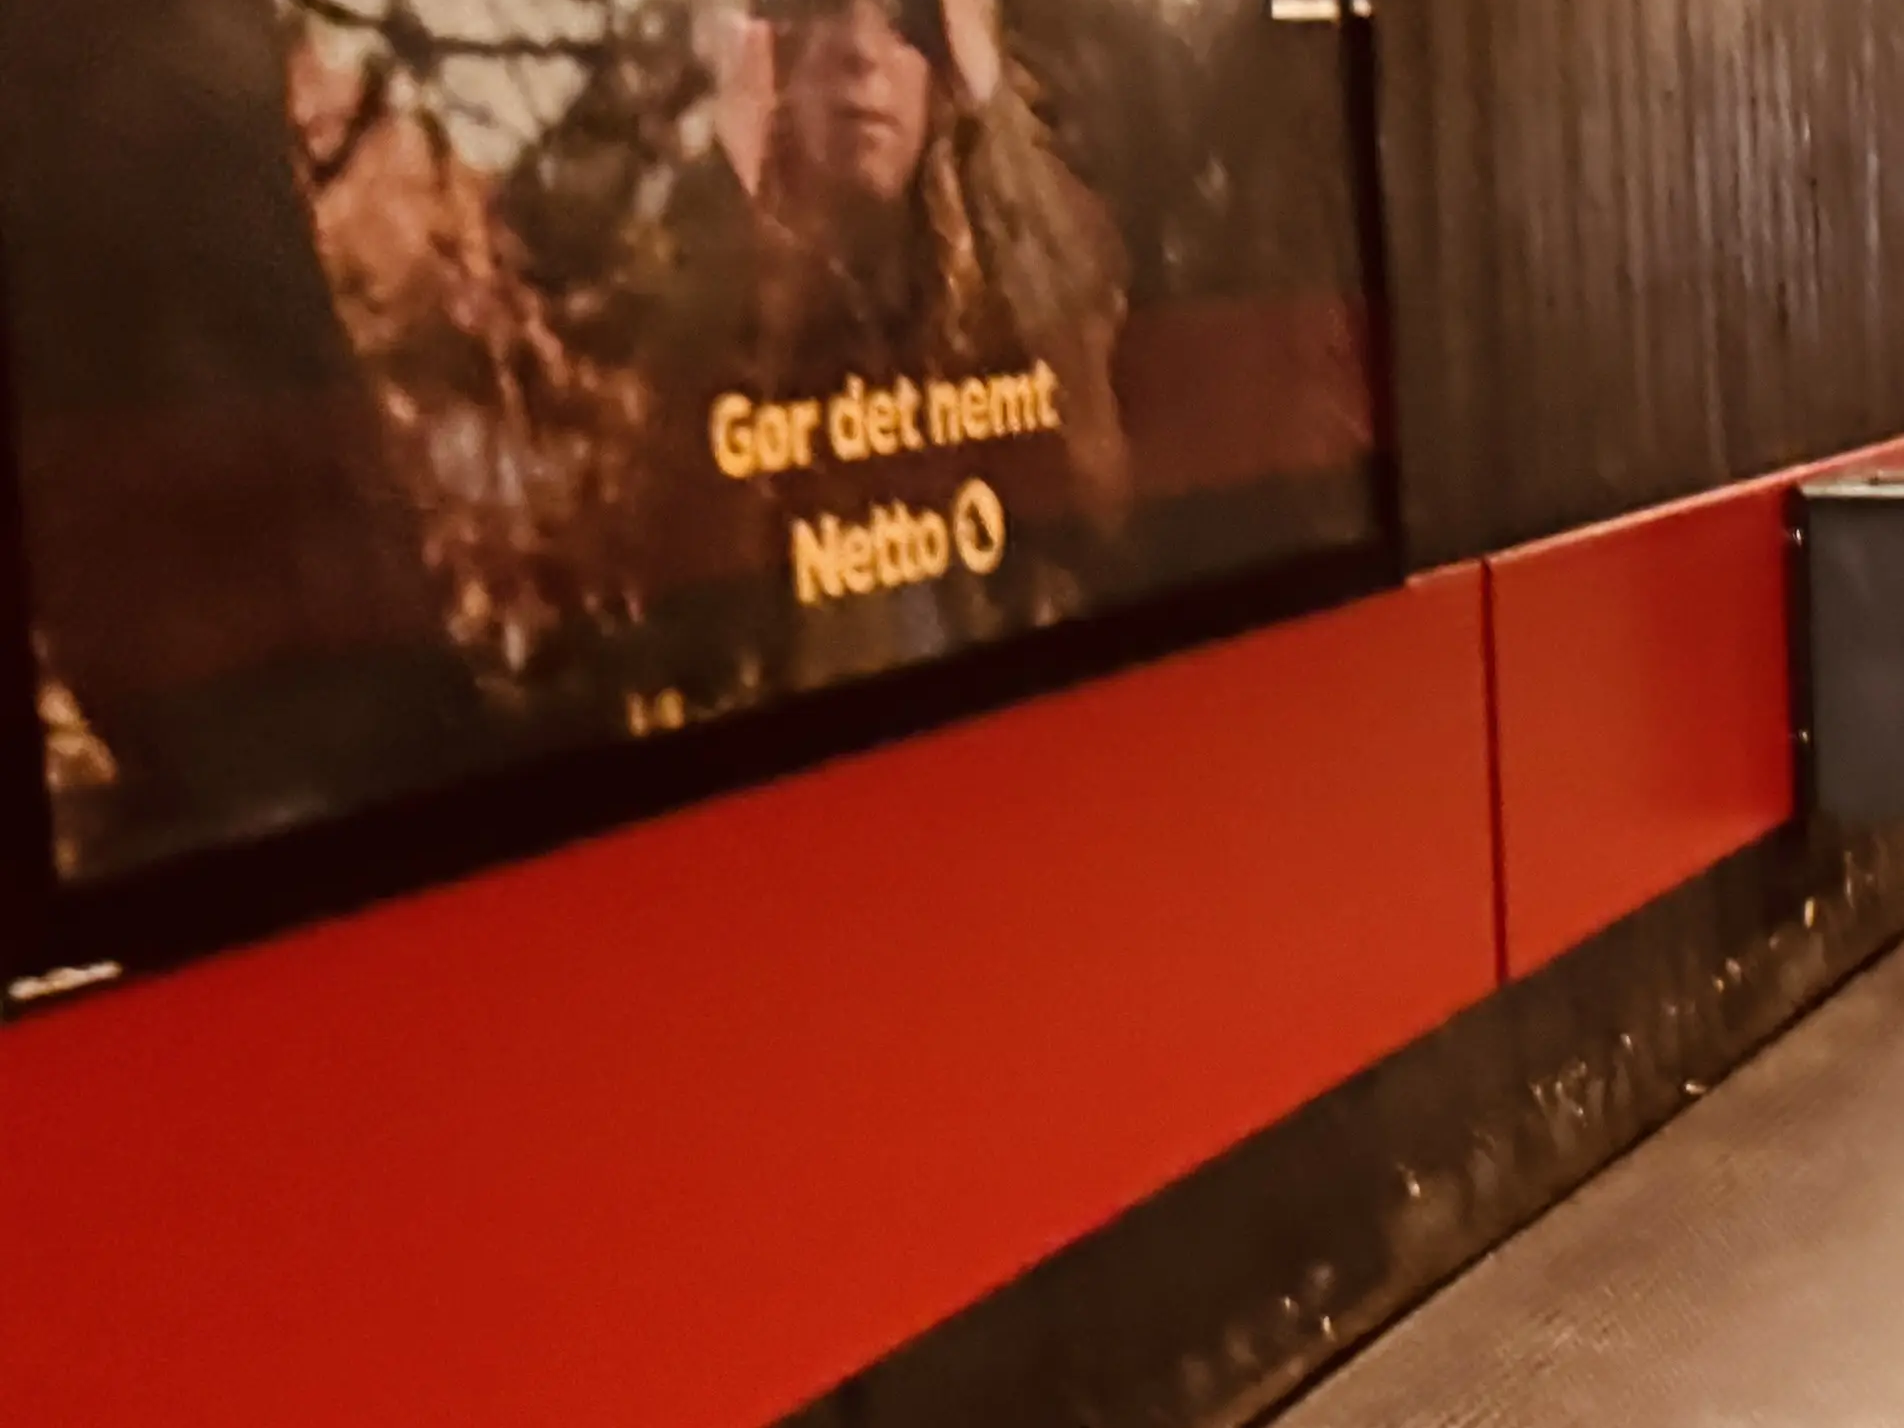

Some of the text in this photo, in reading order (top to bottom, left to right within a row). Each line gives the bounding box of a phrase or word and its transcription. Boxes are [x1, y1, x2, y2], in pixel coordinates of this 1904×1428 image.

[828, 372, 926, 462] det
[926, 358, 1062, 446] nemt
[792, 500, 950, 606] Netto
